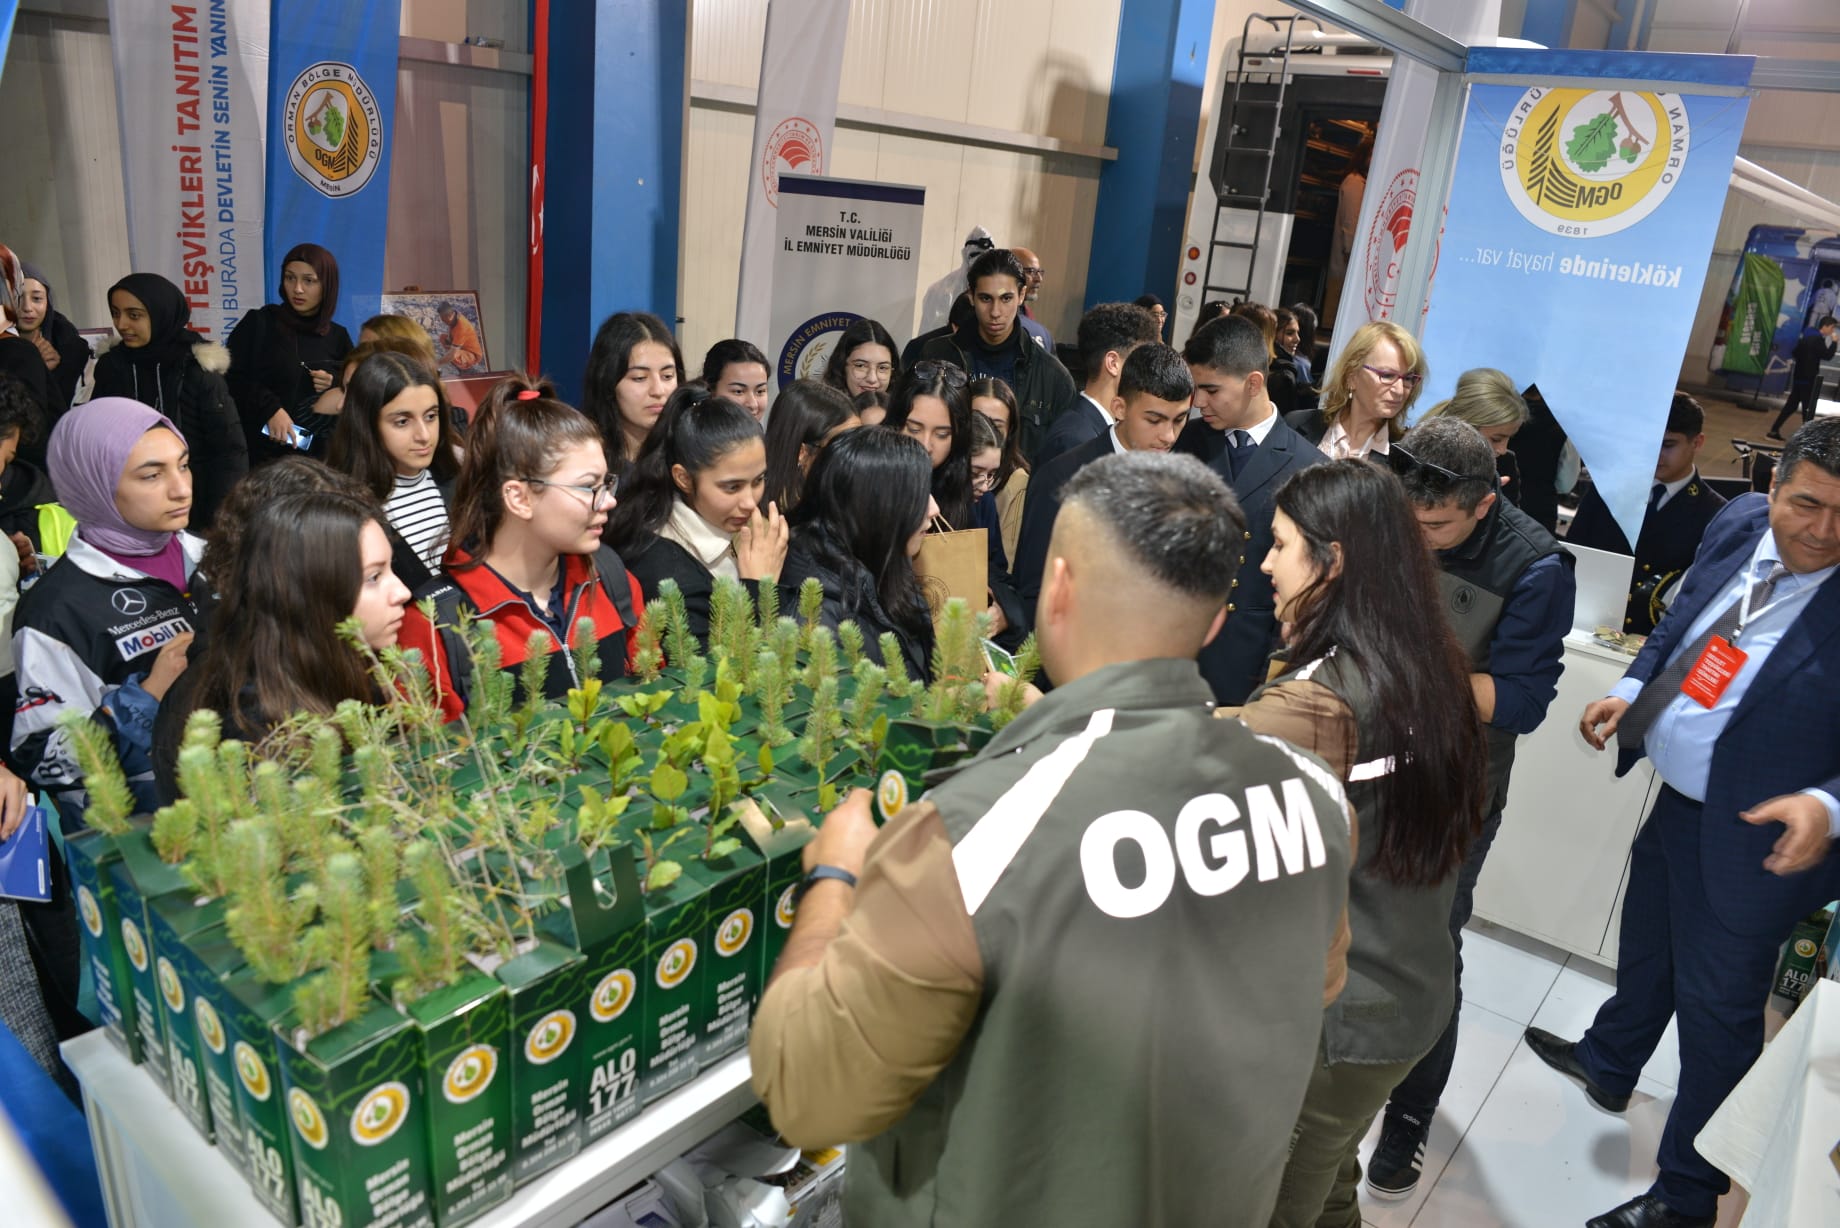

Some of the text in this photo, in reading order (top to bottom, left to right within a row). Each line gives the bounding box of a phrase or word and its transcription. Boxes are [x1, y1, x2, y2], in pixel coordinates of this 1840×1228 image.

[171, 5, 200, 135] TANITIM
[208, 65, 230, 125] SENİN
[288, 68, 379, 159] ORMAN BÖLGE MDÜRLÜĞÜ
[210, 130, 234, 223] DEVLETİN
[314, 148, 336, 169] OGM
[171, 145, 214, 313] TEŞVİKLERİ
[806, 224, 893, 243] MERSİN VALİLİĞİ
[840, 211, 861, 224] T.C.
[219, 228, 238, 310] BURADA
[784, 236, 911, 261] İL EMNİYET MÜDÜRLÜĞÜ
[107, 606, 181, 636] Mercedes-Benz
[122, 624, 175, 656] Mobil
[1080, 777, 1327, 919] OGM
[1784, 968, 1809, 982] ALO
[588, 1069, 636, 1115] 177
[589, 1047, 636, 1095] ALO
